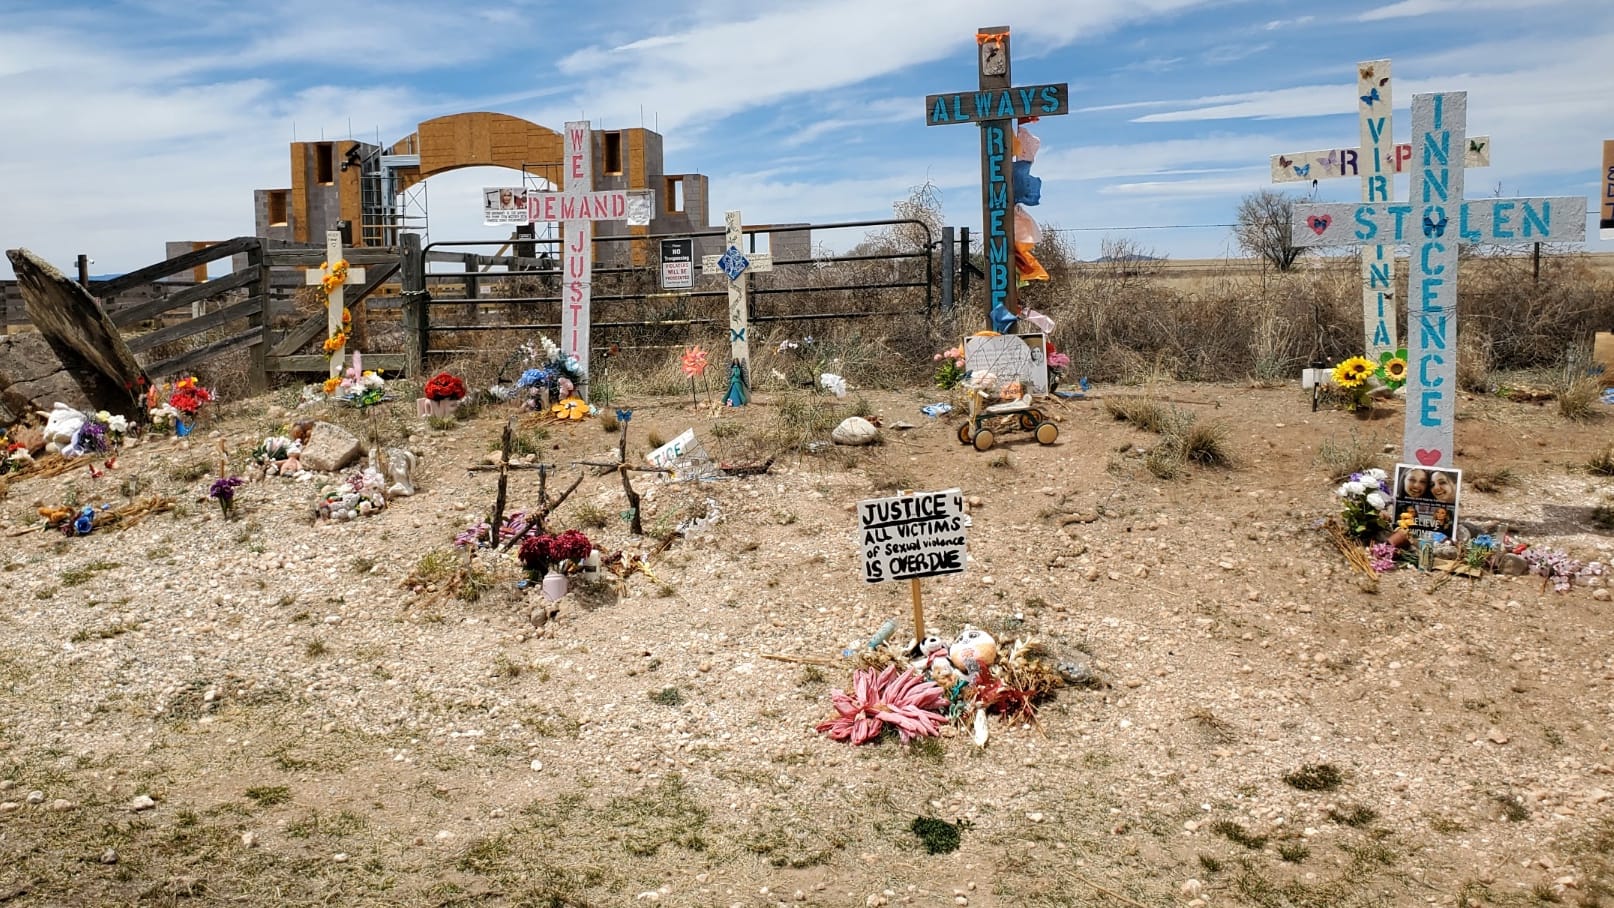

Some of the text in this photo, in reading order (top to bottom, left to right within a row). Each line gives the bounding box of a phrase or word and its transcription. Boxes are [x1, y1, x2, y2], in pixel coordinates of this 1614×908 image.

[932, 86, 1060, 122] ALWAYS
[570, 128, 585, 179] WE
[528, 194, 626, 220] DEMAND
[1354, 201, 1551, 241] STOLEN
[986, 126, 1009, 333] REMEMBE
[1367, 117, 1391, 346] VIRINIA
[1419, 95, 1450, 427] INNOCENCE
[569, 230, 584, 362] JUSTI
[863, 494, 963, 525] JUSTICE 4
[865, 517, 961, 545] ALL VICTIMS
[866, 550, 961, 577] IS OVERDUE
[867, 545, 880, 559] of
